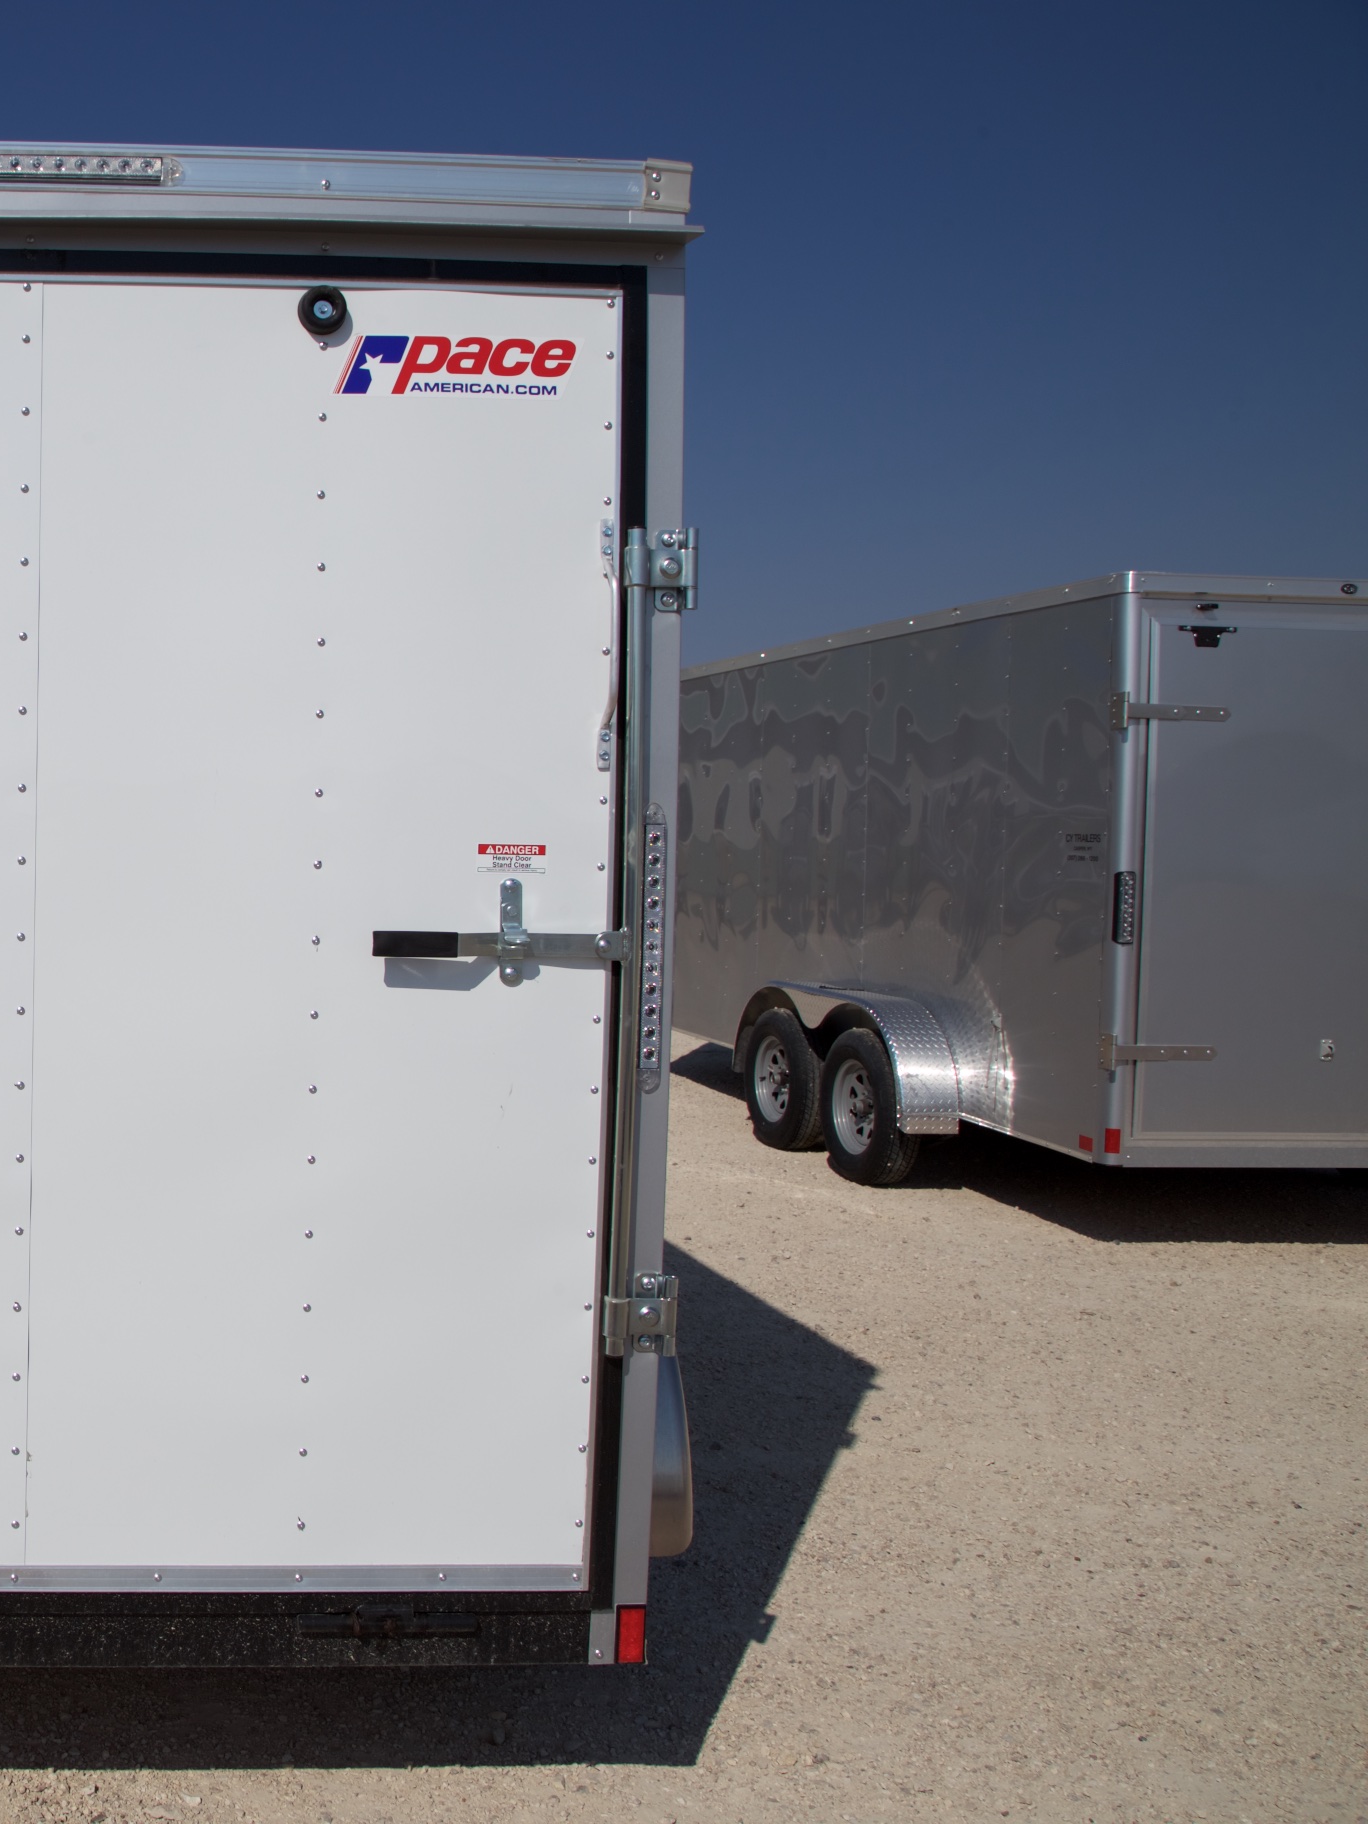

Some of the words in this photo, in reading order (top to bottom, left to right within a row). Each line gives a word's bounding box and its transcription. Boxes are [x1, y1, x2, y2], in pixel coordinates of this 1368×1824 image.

[391, 335, 577, 395] pace
[410, 382, 557, 396] AMERICAN.COM
[1074, 834, 1101, 842] TRAILERS
[496, 845, 539, 854] DANGER
